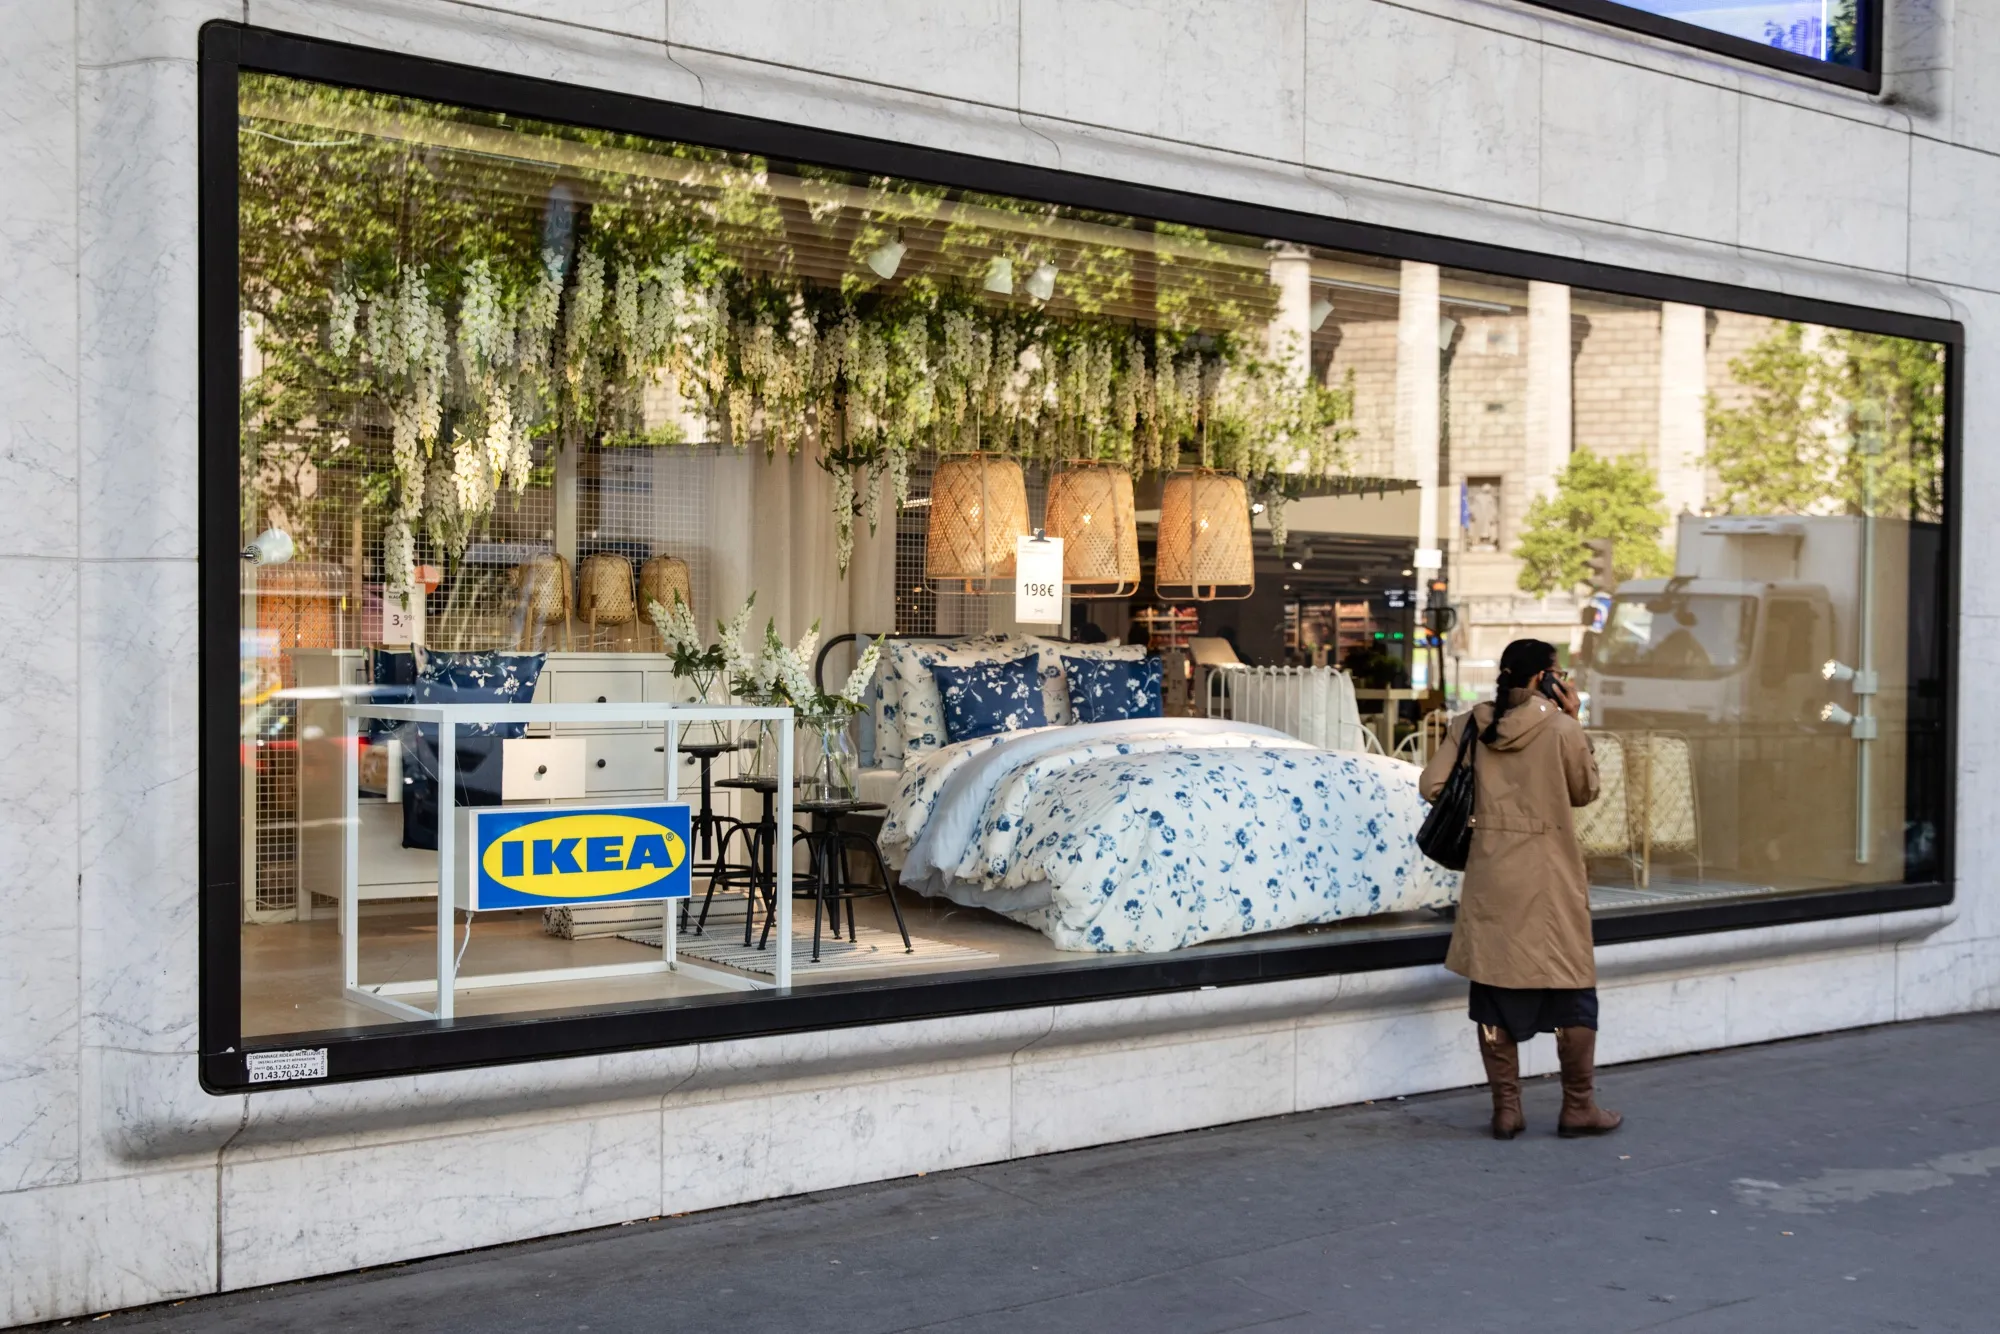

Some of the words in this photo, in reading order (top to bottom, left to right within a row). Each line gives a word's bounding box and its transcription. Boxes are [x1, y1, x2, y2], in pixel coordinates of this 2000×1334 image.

[1023, 583, 1055, 598] 198€
[266, 1063, 307, 1071] 06.12.62.62.12
[253, 1069, 318, 1080] 01.43.70.24.24
